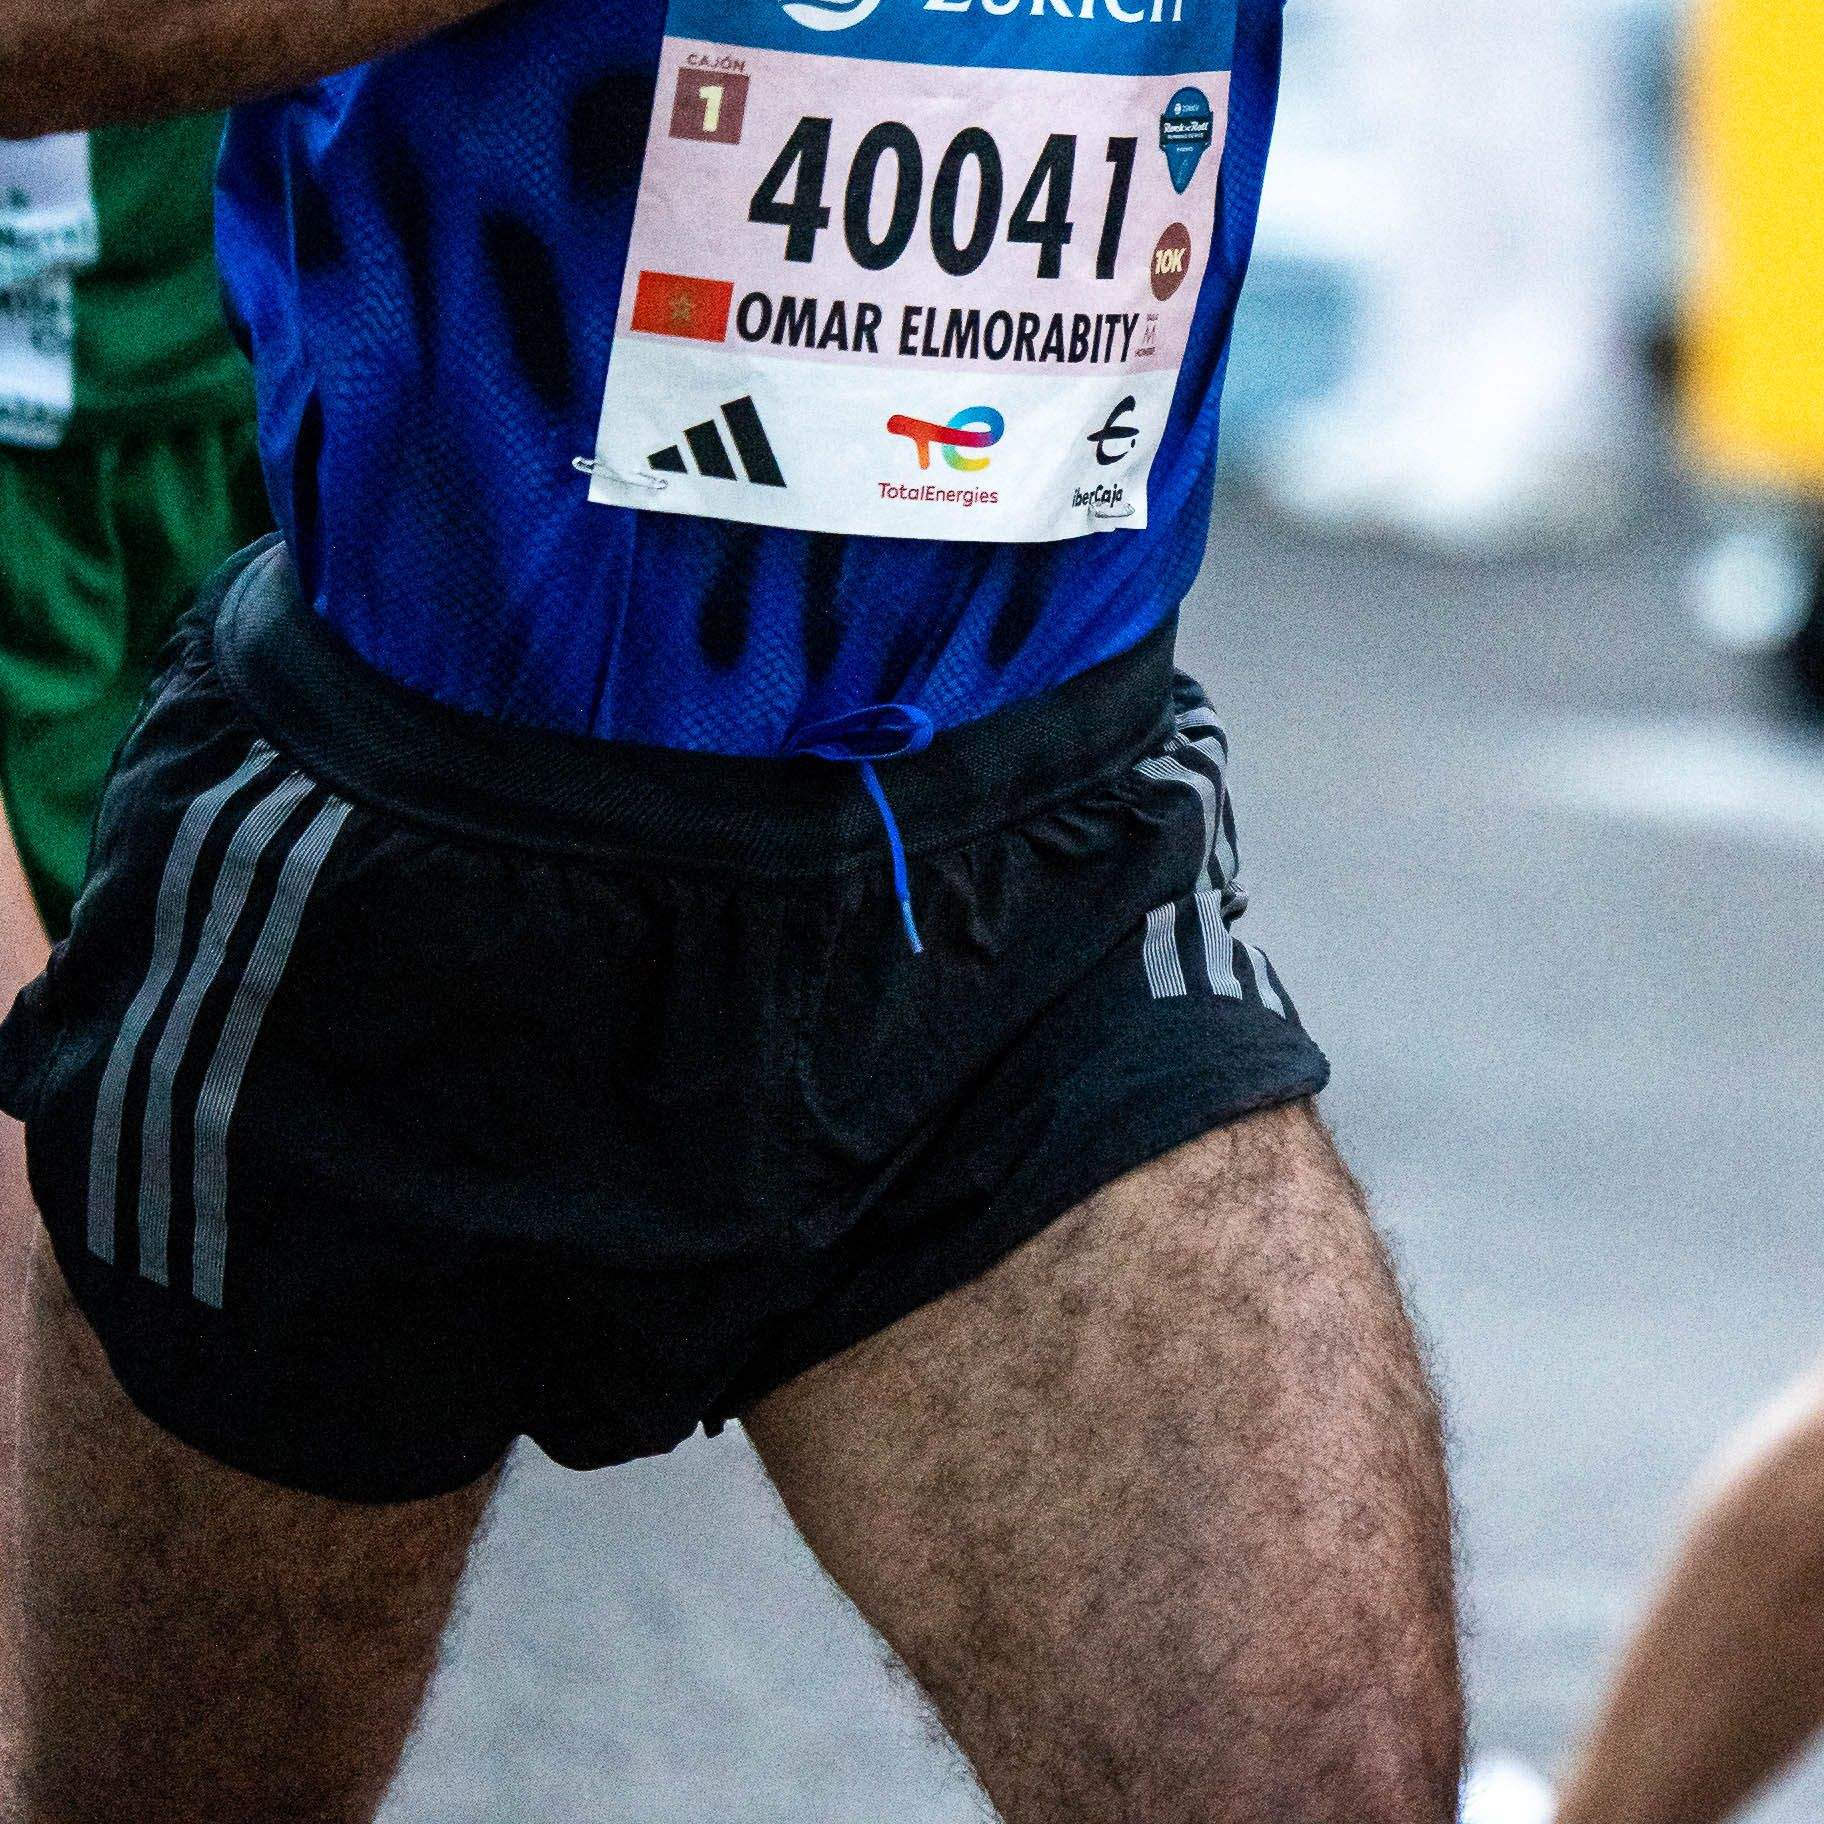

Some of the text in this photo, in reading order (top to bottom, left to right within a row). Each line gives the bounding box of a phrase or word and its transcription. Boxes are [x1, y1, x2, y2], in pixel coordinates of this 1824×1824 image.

[699, 85, 725, 133] 1
[748, 116, 1138, 280] 40041
[1155, 248, 1187, 274] 10K
[736, 291, 1140, 364] OMAR ELMORABITY
[878, 482, 999, 507] TotalEnergies
[1072, 484, 1123, 508] iberCaja
